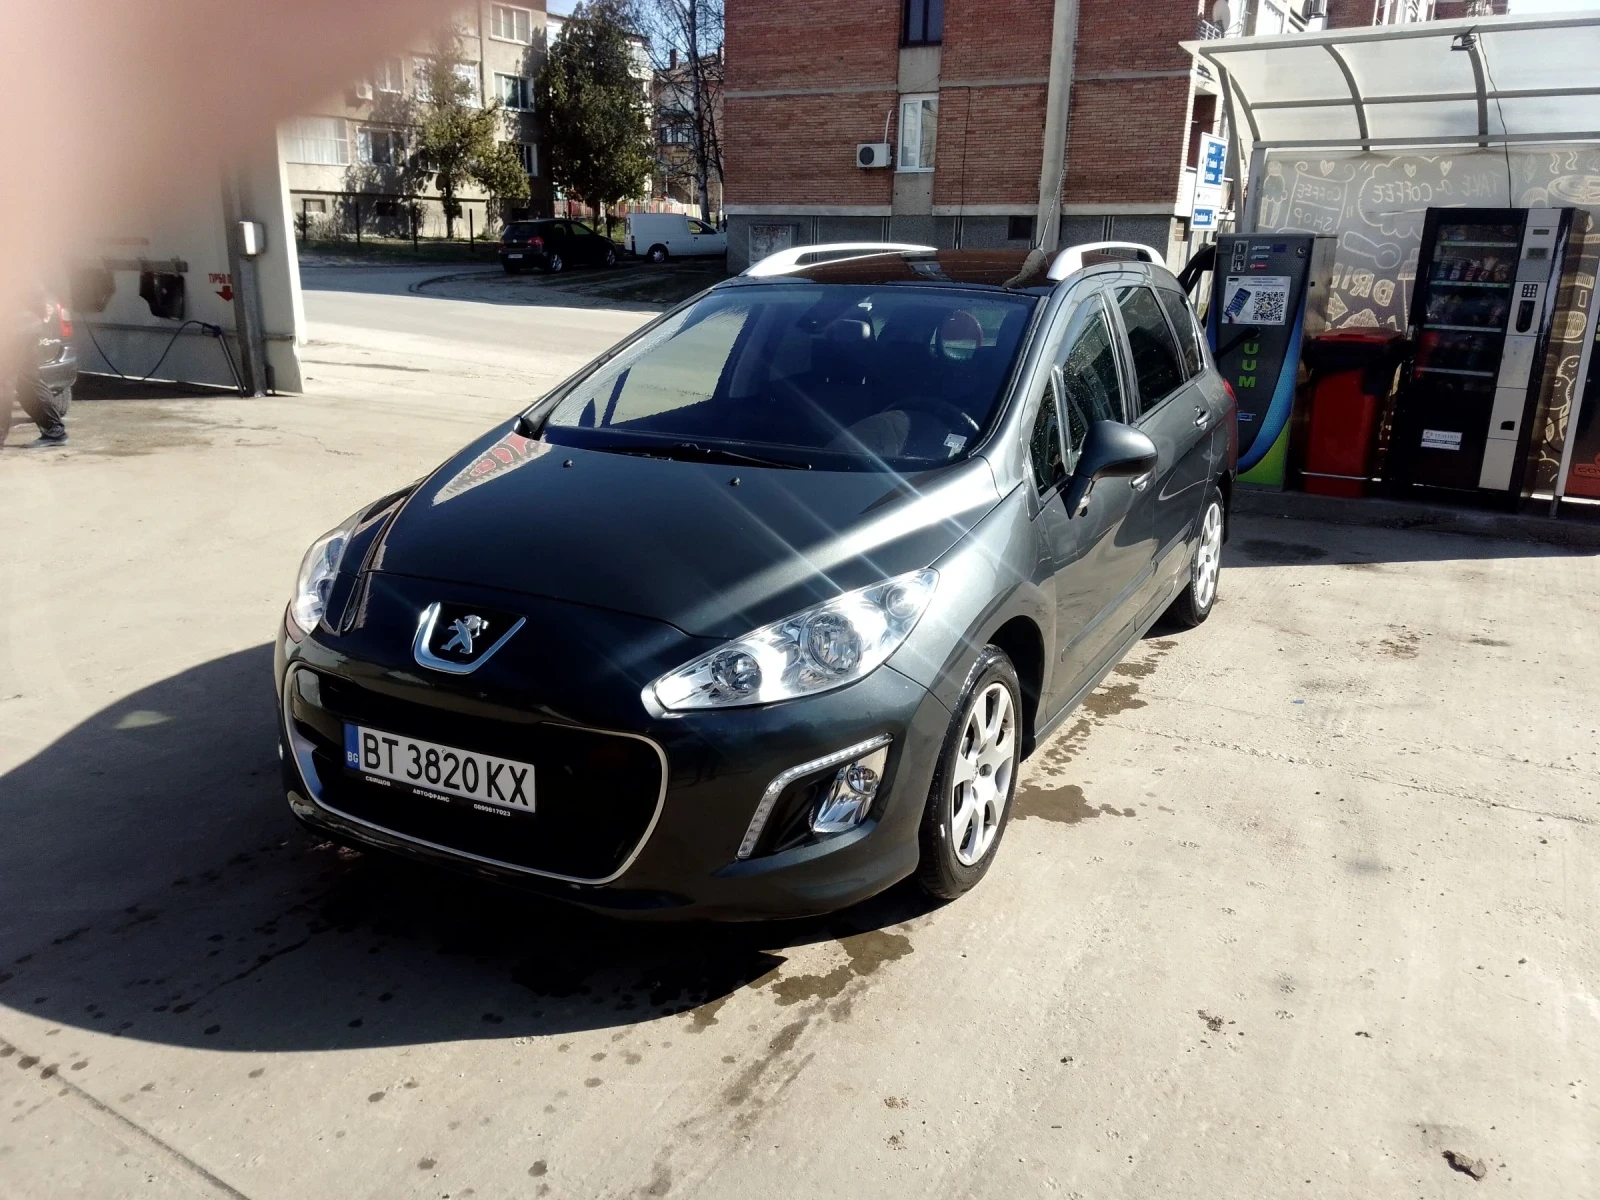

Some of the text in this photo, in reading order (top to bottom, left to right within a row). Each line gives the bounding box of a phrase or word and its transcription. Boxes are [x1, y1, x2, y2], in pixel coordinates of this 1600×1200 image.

[347, 751, 359, 763] BG
[363, 732, 529, 806] BT 3820 KX
